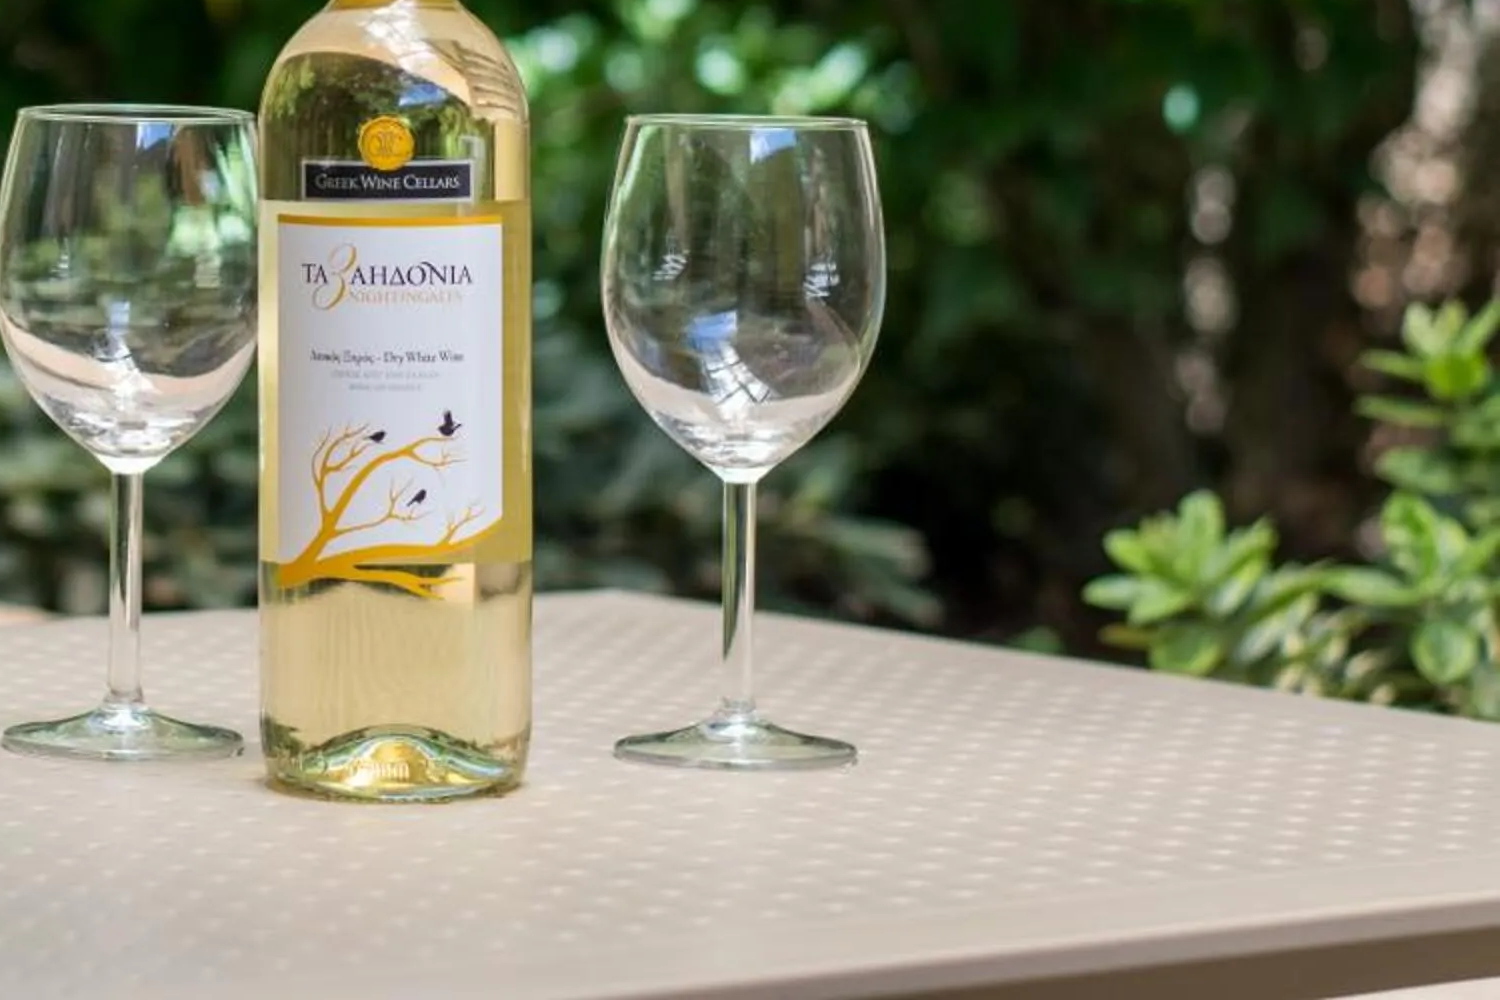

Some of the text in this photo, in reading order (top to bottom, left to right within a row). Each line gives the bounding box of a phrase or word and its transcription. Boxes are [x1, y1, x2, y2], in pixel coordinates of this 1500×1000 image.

[314, 173, 461, 190] GREEK WINE CELLARS
[383, 351, 404, 366] Dry
